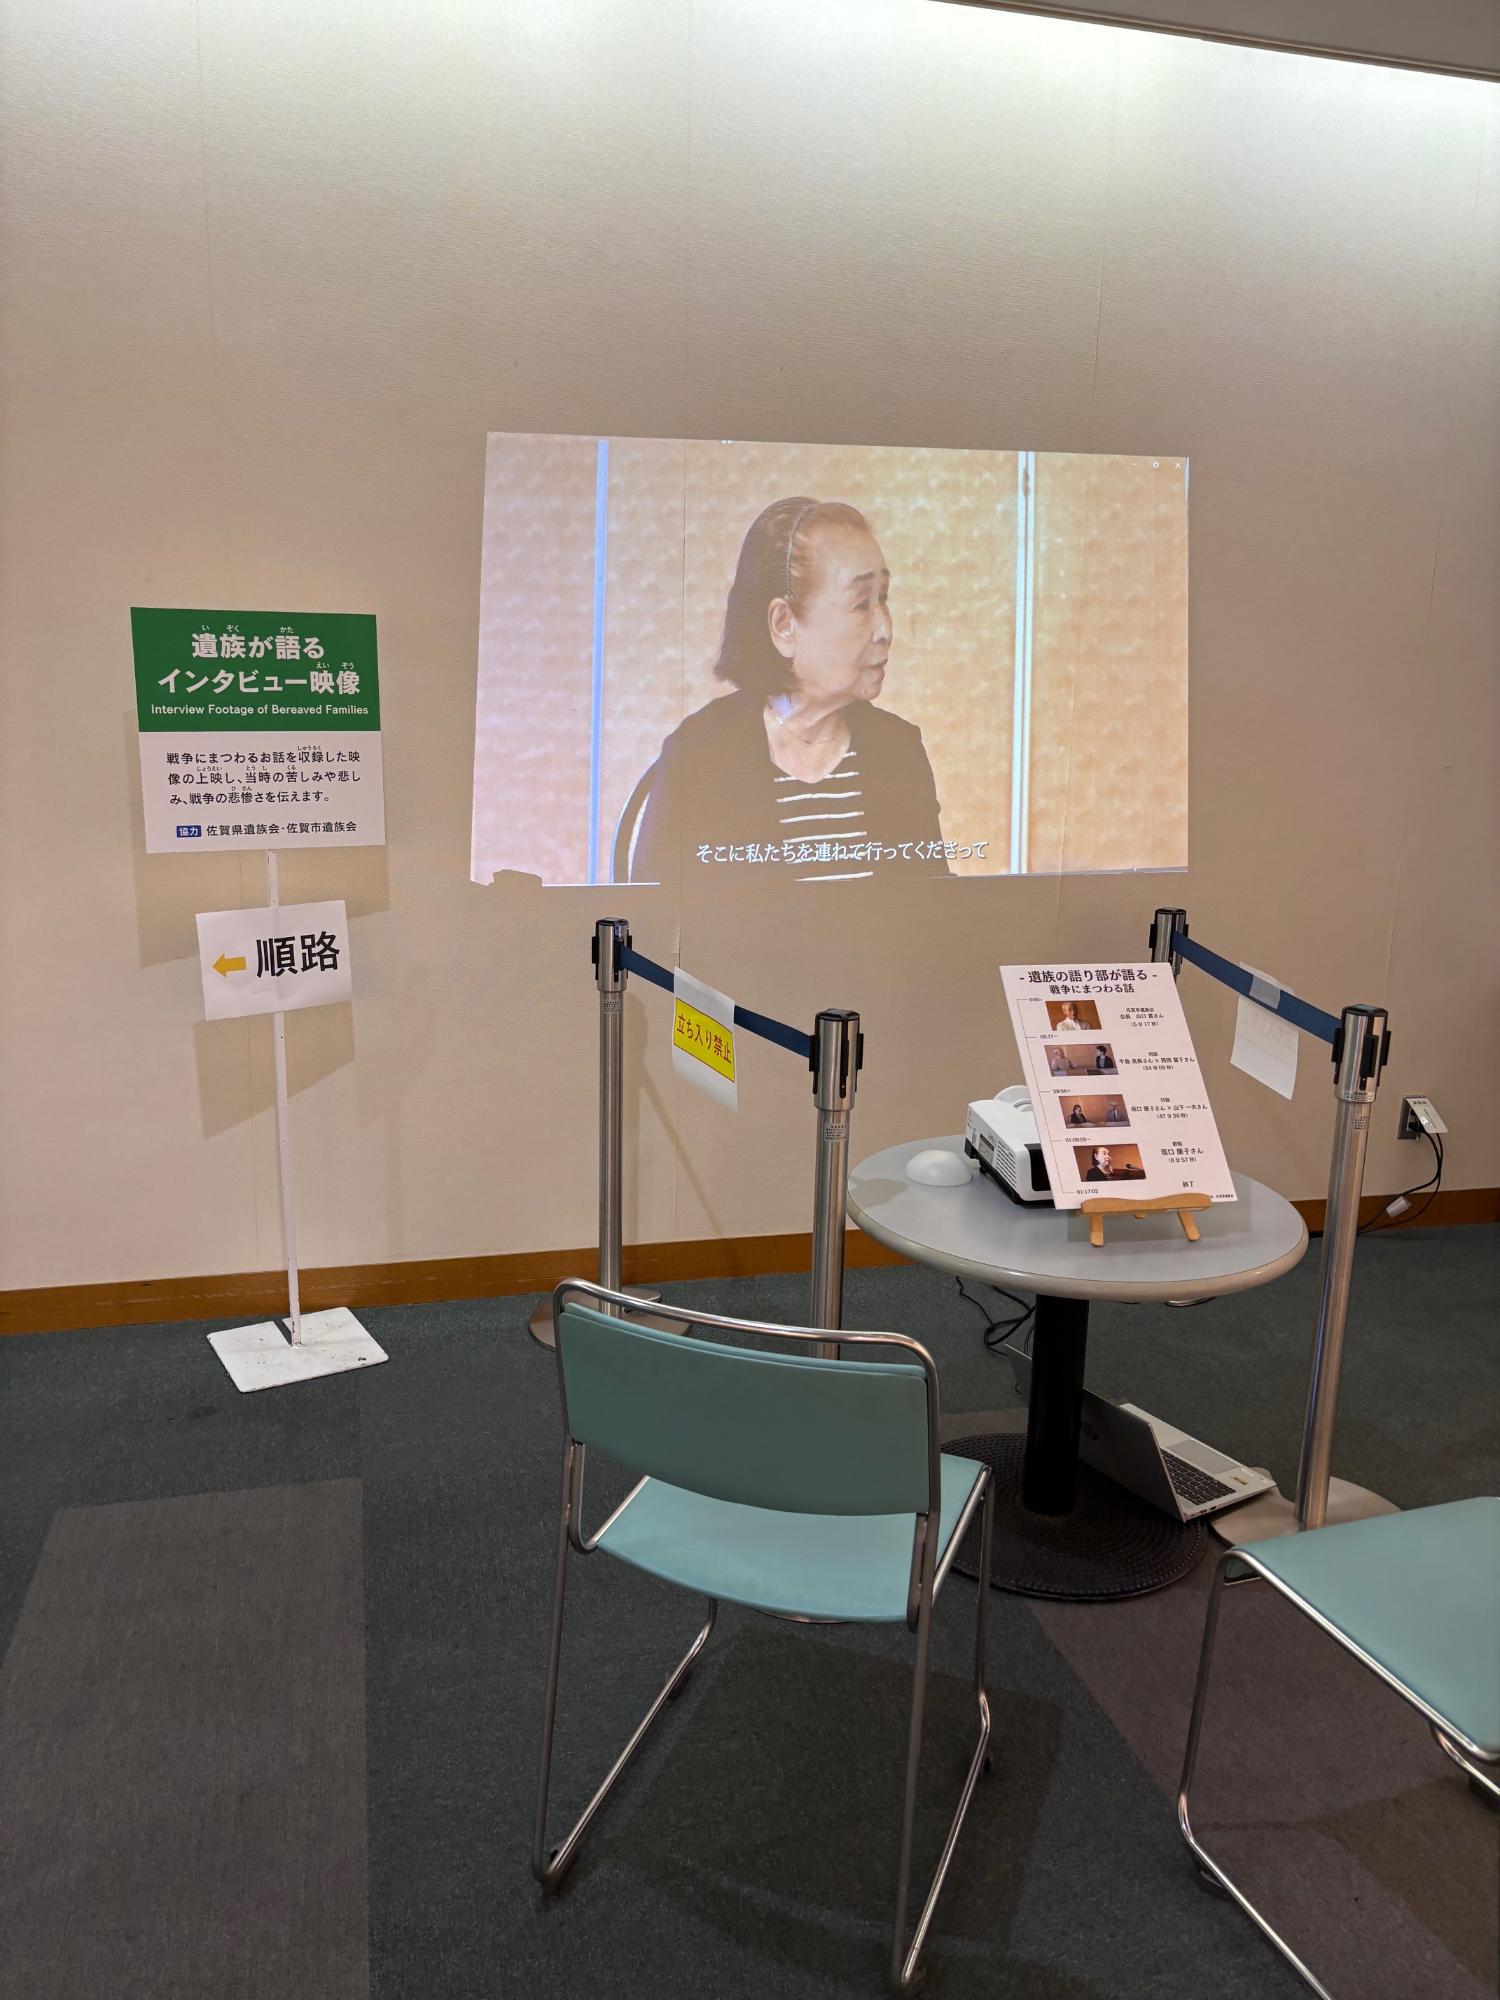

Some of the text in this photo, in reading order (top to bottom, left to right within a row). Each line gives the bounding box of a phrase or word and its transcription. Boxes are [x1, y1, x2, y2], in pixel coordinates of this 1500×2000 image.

[191, 632, 325, 660] 遺族が語る
[158, 668, 361, 695] インタビュー映像
[151, 704, 369, 716] Interview Footage of Bereaved Families
[166, 751, 361, 765] 戦争にまつわるお話を収録した映
[167, 771, 361, 786] 像の上映し、当時の苦しみや悲し
[169, 790, 330, 805] み、戦争の悲惨さを伝えます。
[179, 826, 200, 837] 協力
[696, 841, 989, 864] そこに私たちを連れて行ってくださって
[256, 931, 340, 978] 順路
[1028, 968, 1148, 984] 遺族の語り部が語る
[1050, 984, 1135, 995] 戦争にまつわる話
[676, 1014, 732, 1064] 立ち入り禁止
